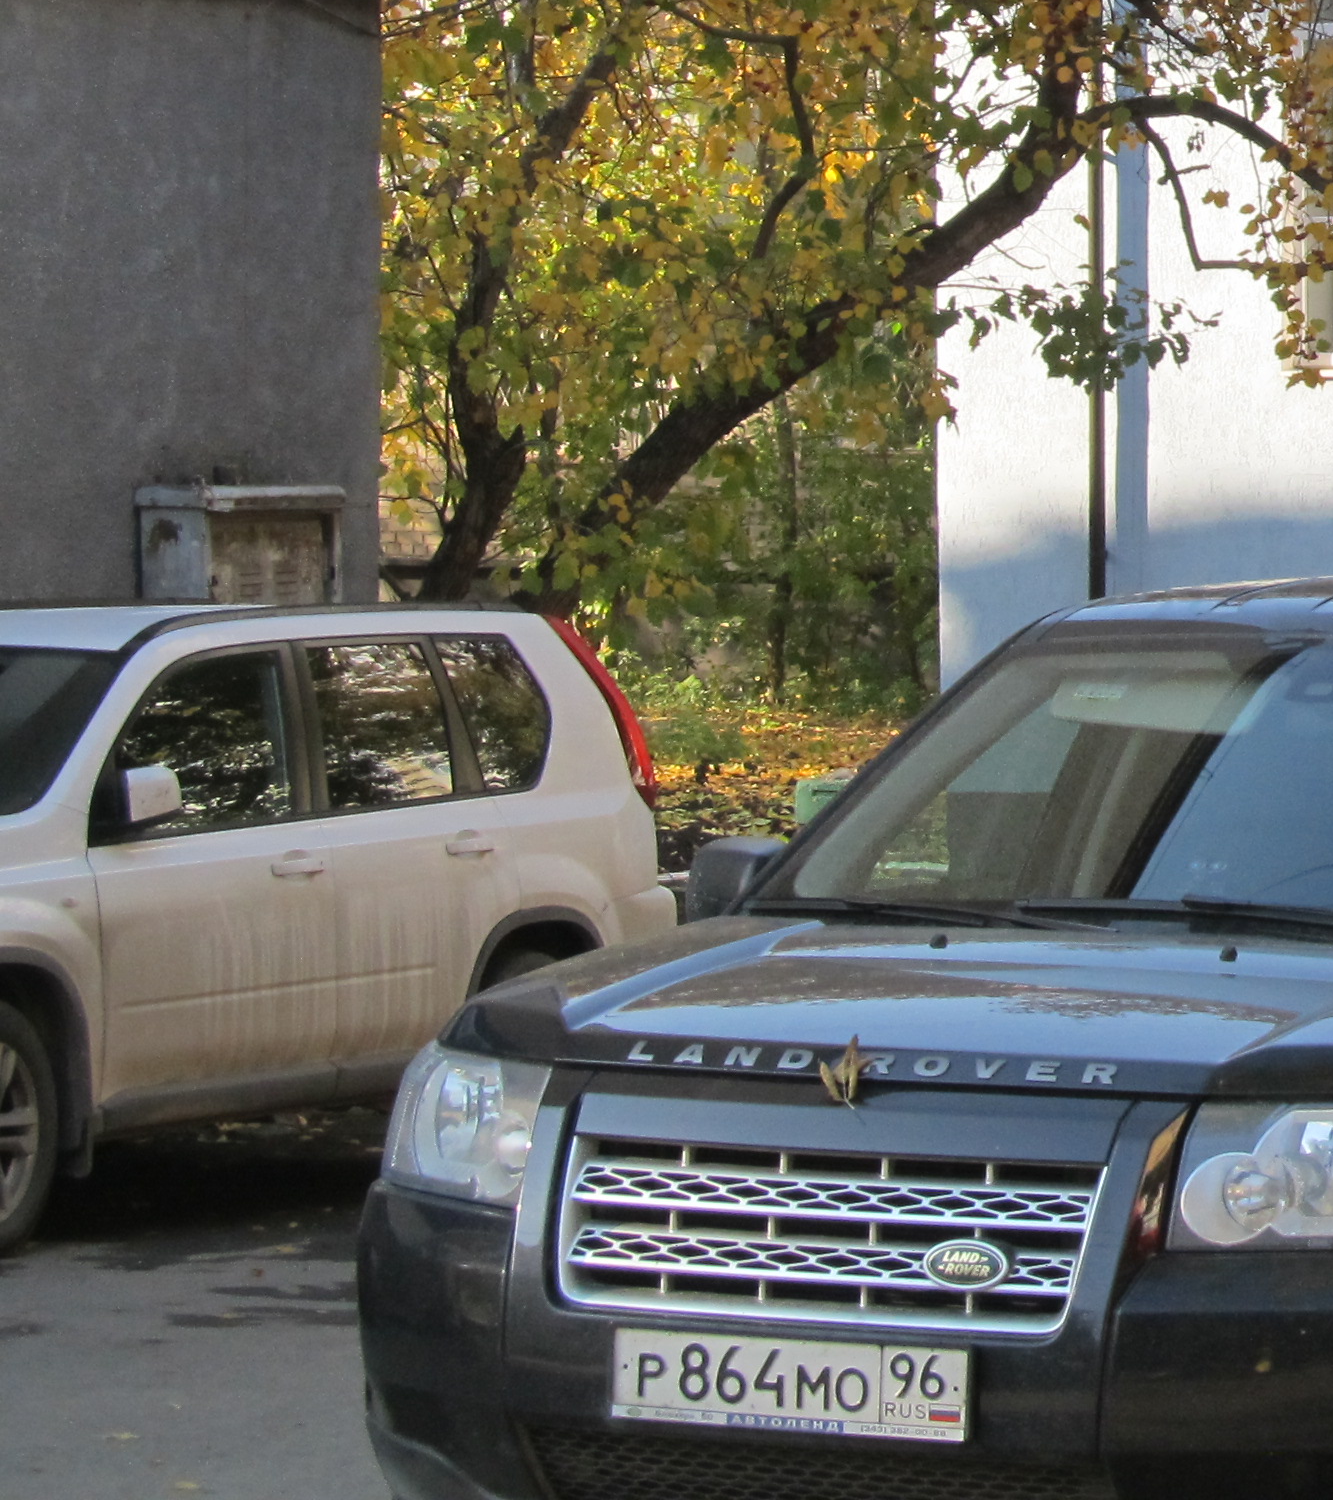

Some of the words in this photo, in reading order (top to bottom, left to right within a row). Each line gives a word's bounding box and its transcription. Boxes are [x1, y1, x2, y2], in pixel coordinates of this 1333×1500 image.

[626, 1039, 814, 1071] LAND
[862, 1050, 1119, 1085] ROVER
[889, 1351, 946, 1400] 96
[731, 1414, 840, 1434] АВТОЛЕНД
[884, 1401, 927, 1421] RUS
